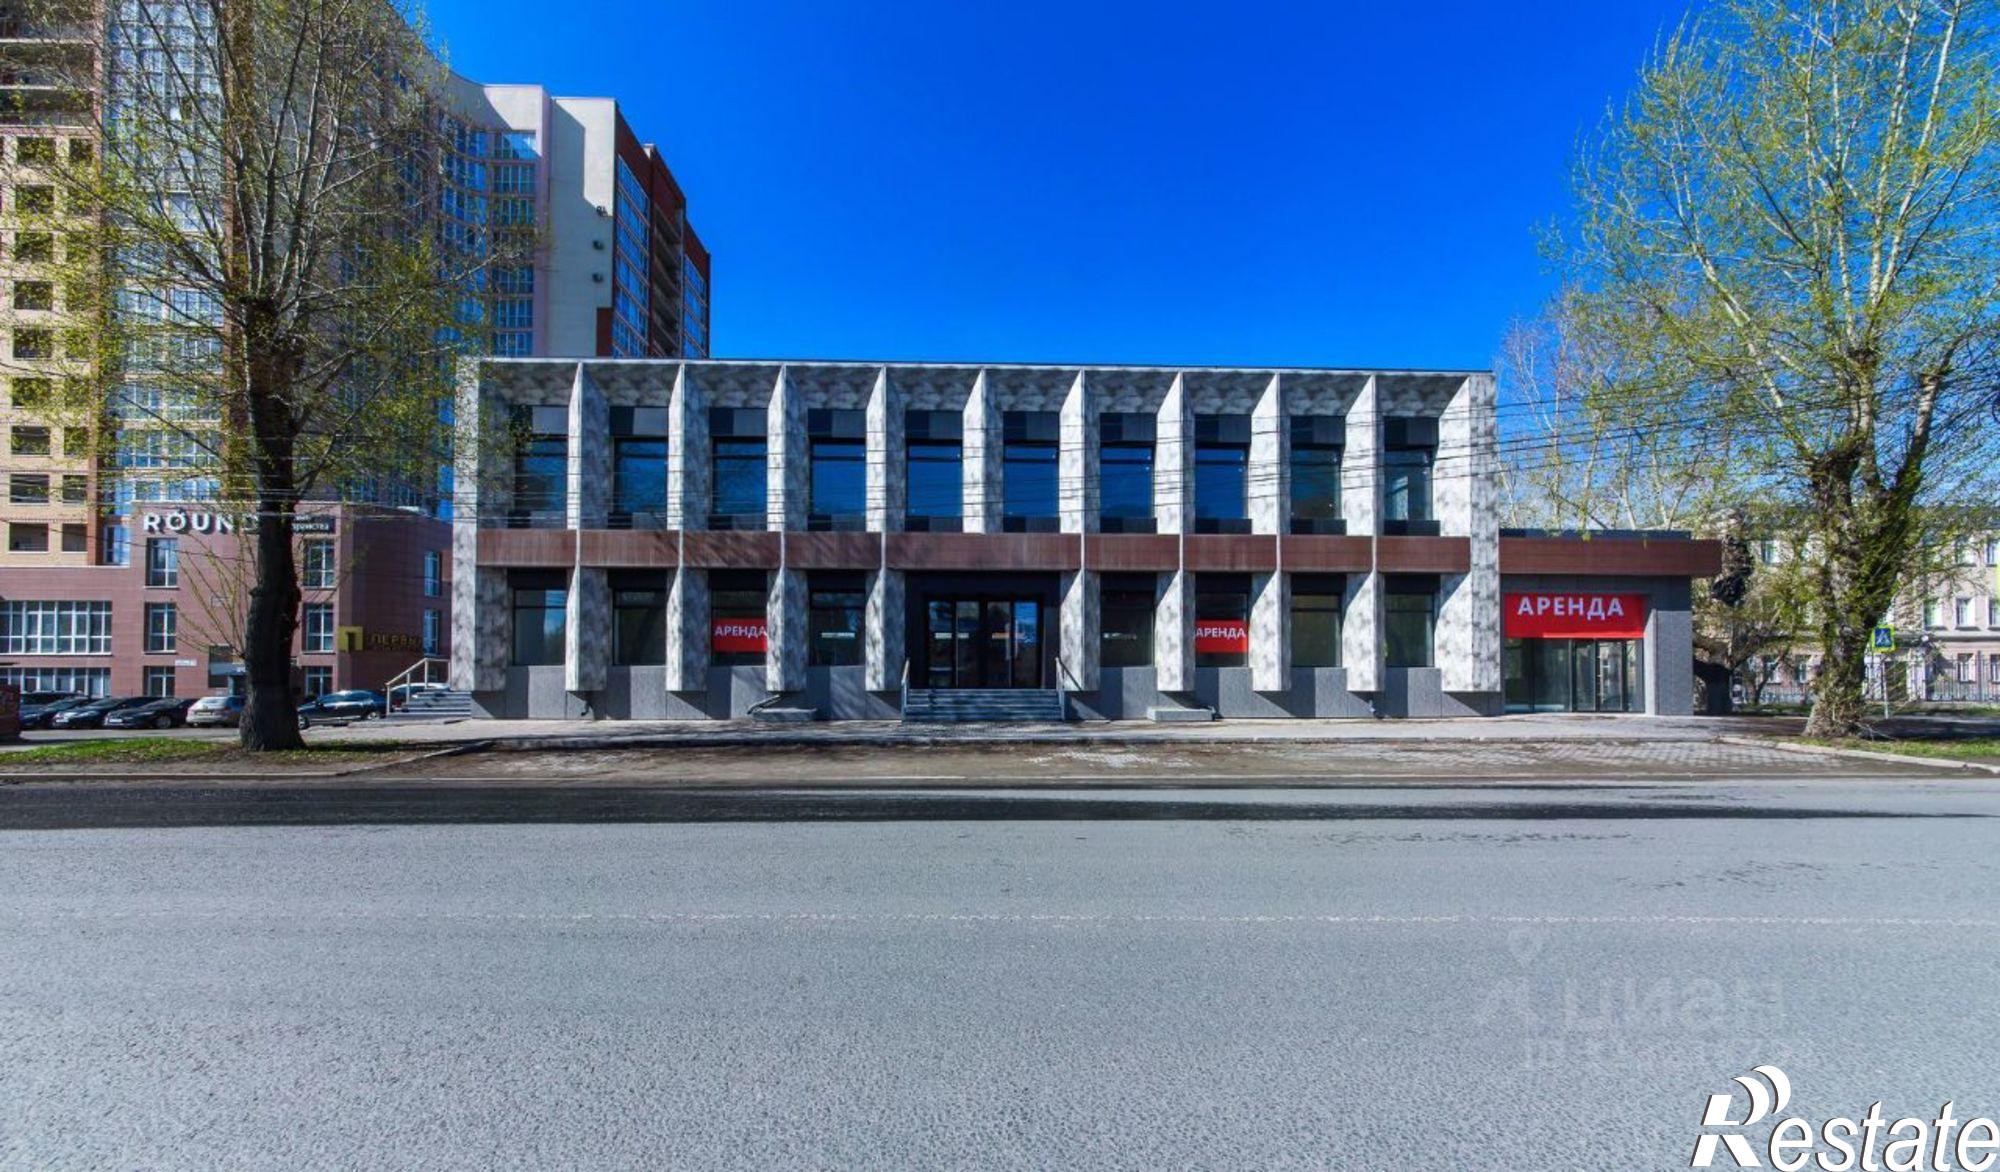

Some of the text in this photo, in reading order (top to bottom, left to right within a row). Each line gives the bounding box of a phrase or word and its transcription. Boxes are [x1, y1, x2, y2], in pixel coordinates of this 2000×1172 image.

[1517, 596, 1624, 621] АРЕНДА
[715, 626, 768, 638] АРЕНДА
[1196, 627, 1246, 639] АРЕНДА
